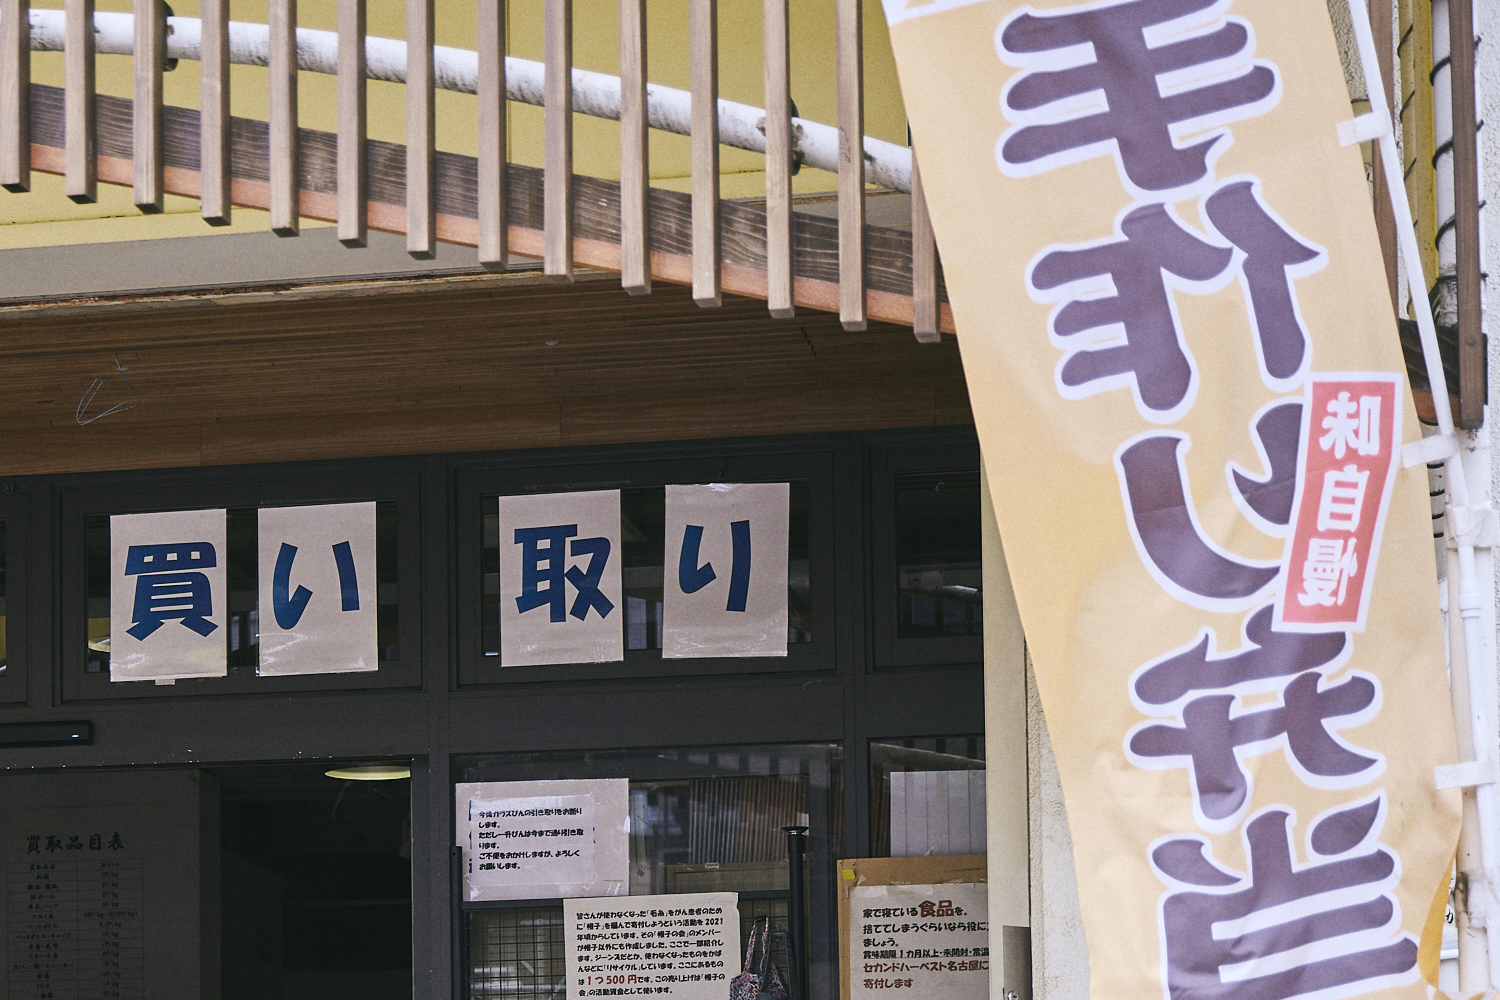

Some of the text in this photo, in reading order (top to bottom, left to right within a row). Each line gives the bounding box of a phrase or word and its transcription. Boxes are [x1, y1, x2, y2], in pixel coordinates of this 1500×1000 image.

[123, 539, 361, 642] 買い
[513, 518, 751, 624] 取り
[479, 829, 584, 839] ただし一升びんは今まで通り引き取
[26, 831, 124, 854] 買取品目表
[479, 850, 580, 859] ご不便をおかけしますが、よろしく
[863, 900, 968, 918] 家で寝ている食品を。
[863, 922, 989, 934] 捨ててしまうぐらいなら役に
[863, 938, 899, 947] ましょう。
[863, 960, 989, 973] セカンドハーベスト名古屋に
[864, 978, 913, 989] 寄付します
